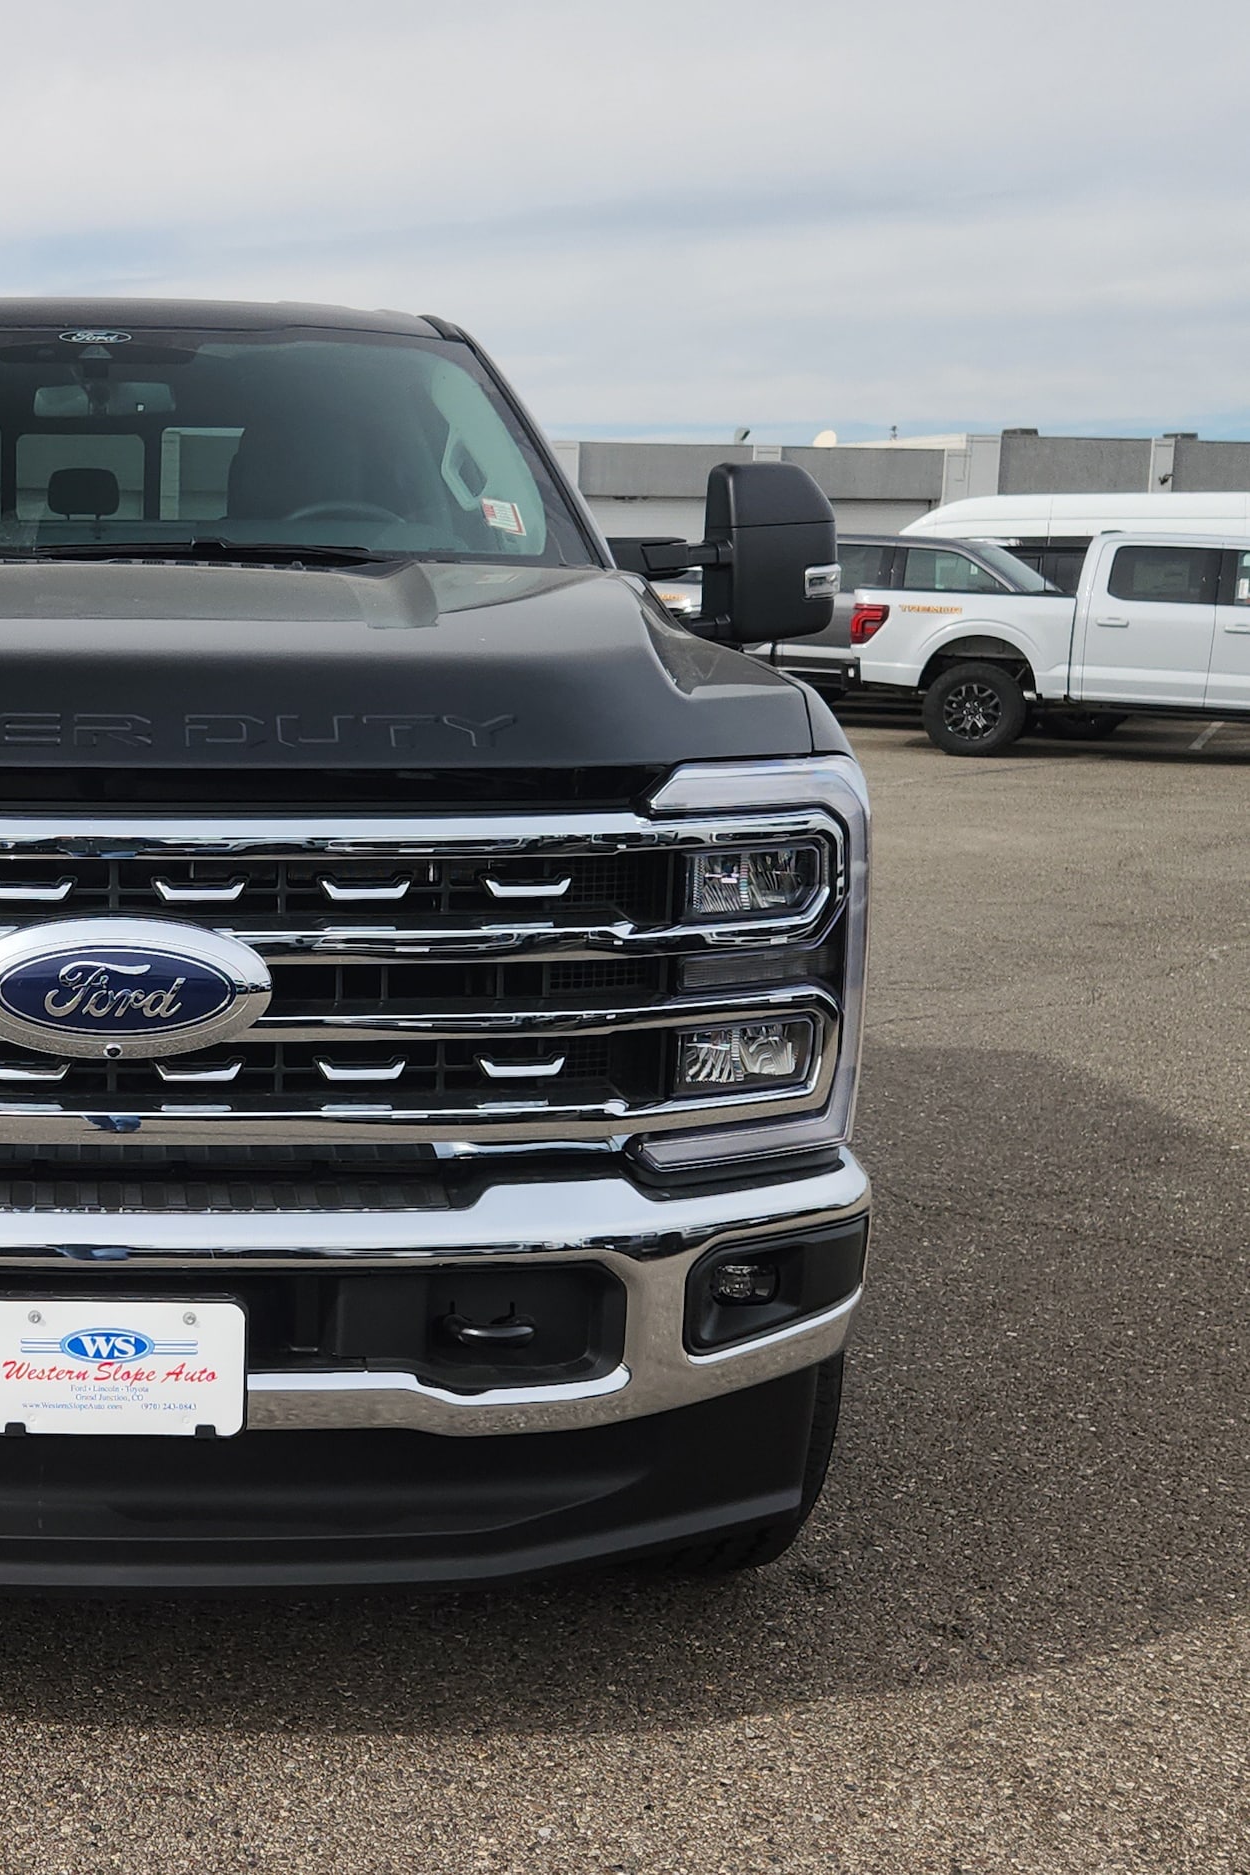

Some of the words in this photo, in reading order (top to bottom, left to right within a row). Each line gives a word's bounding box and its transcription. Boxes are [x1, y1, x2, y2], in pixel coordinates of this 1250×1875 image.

[71, 330, 118, 341] Ford
[898, 604, 964, 615] TREMOR
[184, 713, 518, 748] DUTY
[44, 960, 187, 1018] Ford
[77, 1335, 137, 1359] WS
[2, 1360, 90, 1382] Western
[93, 1362, 157, 1387] Slope
[160, 1362, 218, 1384] Auto
[70, 1384, 87, 1393] Ford
[92, 1385, 120, 1393] Lincoln
[125, 1385, 149, 1394] Toyota
[75, 1393, 97, 1401] Grand
